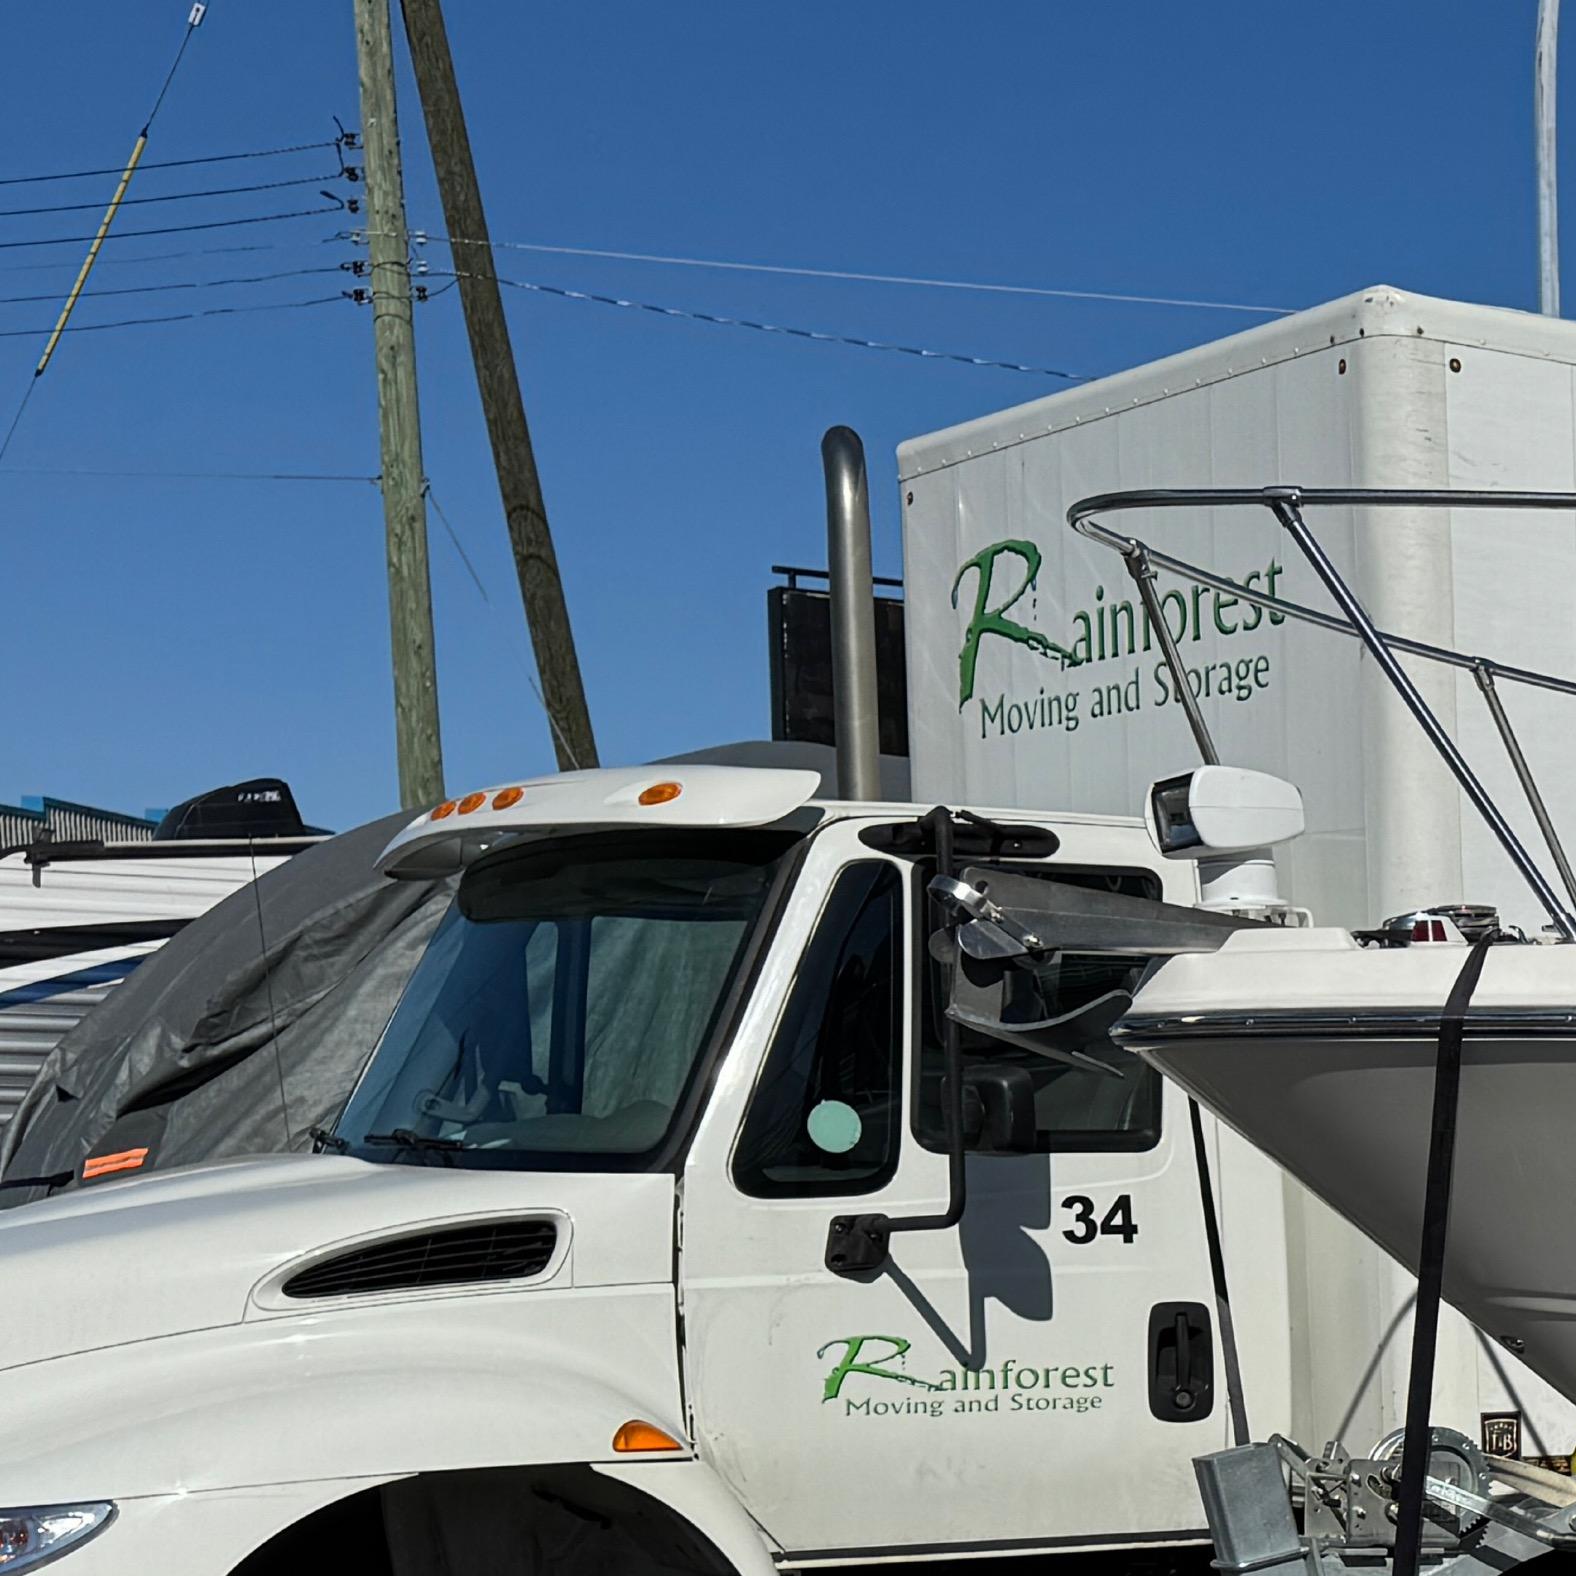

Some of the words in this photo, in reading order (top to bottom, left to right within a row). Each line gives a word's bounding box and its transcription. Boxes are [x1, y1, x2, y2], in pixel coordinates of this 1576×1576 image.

[979, 686, 1079, 739] Moving
[1090, 666, 1140, 718] and
[1061, 1194, 1138, 1245] 34
[816, 1335, 1115, 1403] Rainforest
[845, 1396, 944, 1417] Moving
[954, 1395, 999, 1413] and
[1011, 1393, 1103, 1413] Storage
